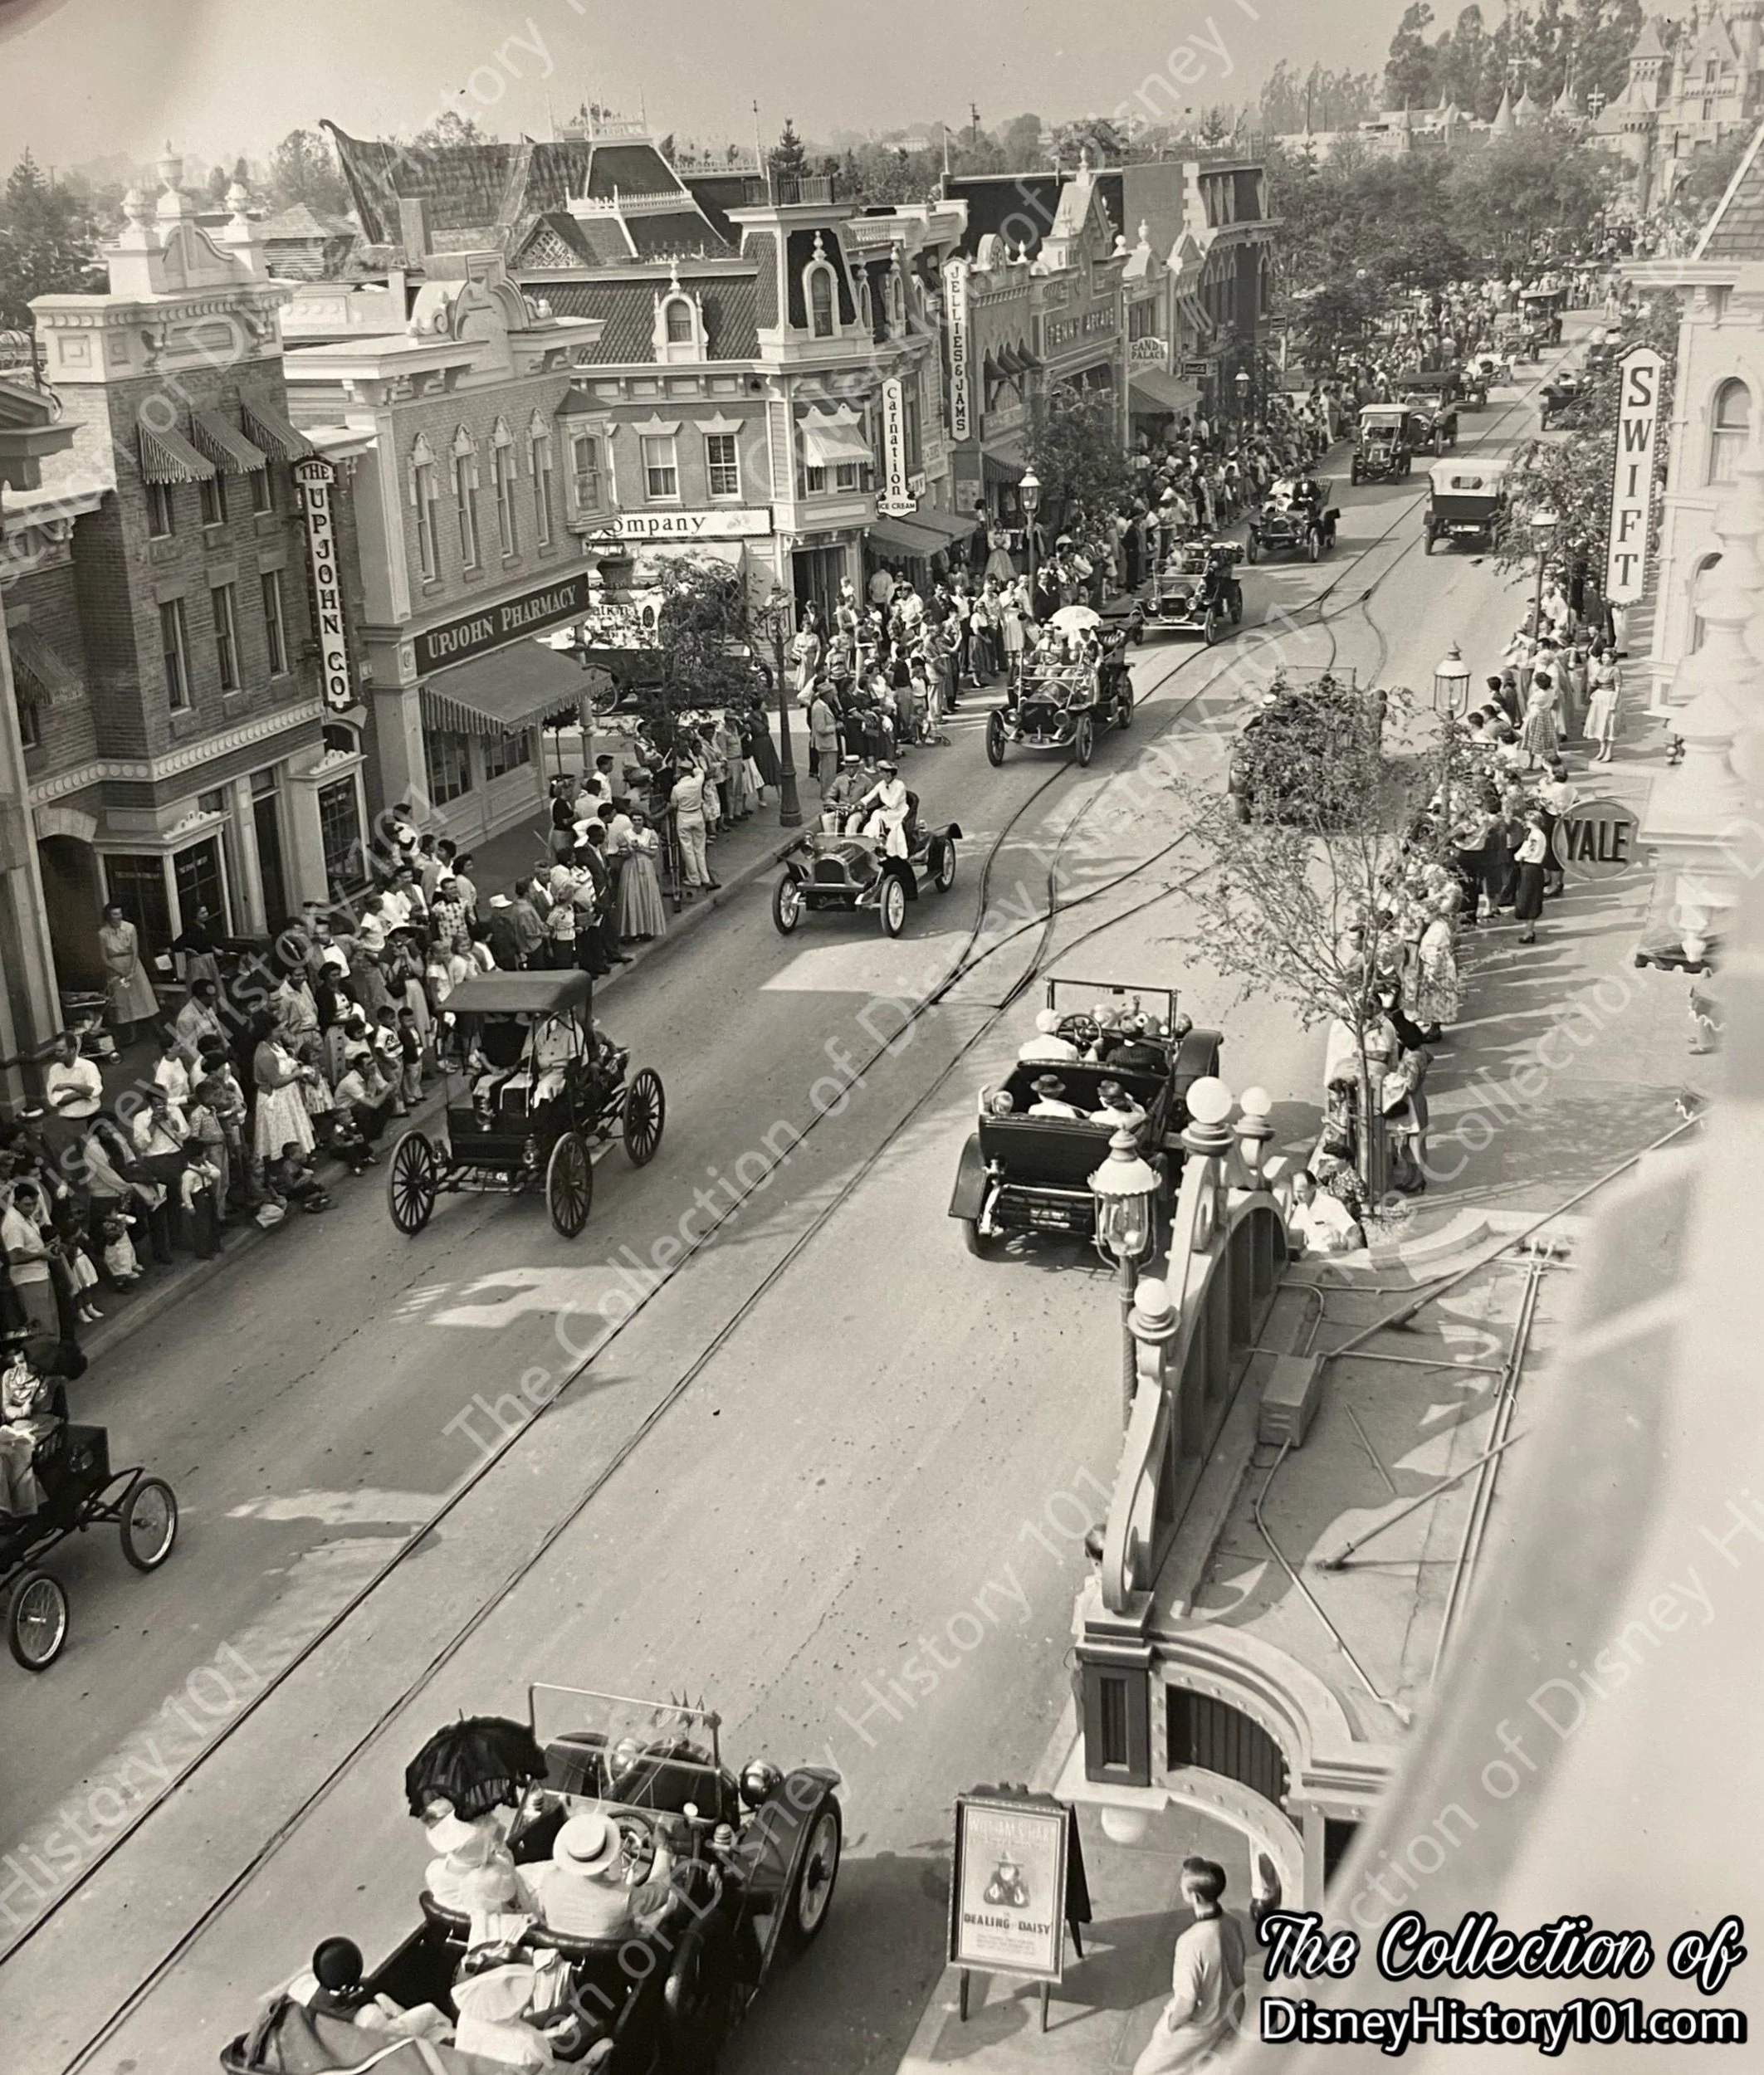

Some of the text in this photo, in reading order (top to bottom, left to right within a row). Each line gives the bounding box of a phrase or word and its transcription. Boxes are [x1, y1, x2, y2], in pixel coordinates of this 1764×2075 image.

[950, 266, 966, 431] JELLIES & JAMS
[299, 463, 330, 480] THE
[887, 386, 902, 496] Carnation
[1615, 366, 1654, 586] SWIFT
[308, 487, 340, 634] UPJOHN
[427, 584, 576, 659] UPJOHN PHARMACY
[1563, 818, 1630, 862] YALE
[964, 1912, 1010, 1930] DEALING
[1018, 1920, 1050, 1935] DAISY
